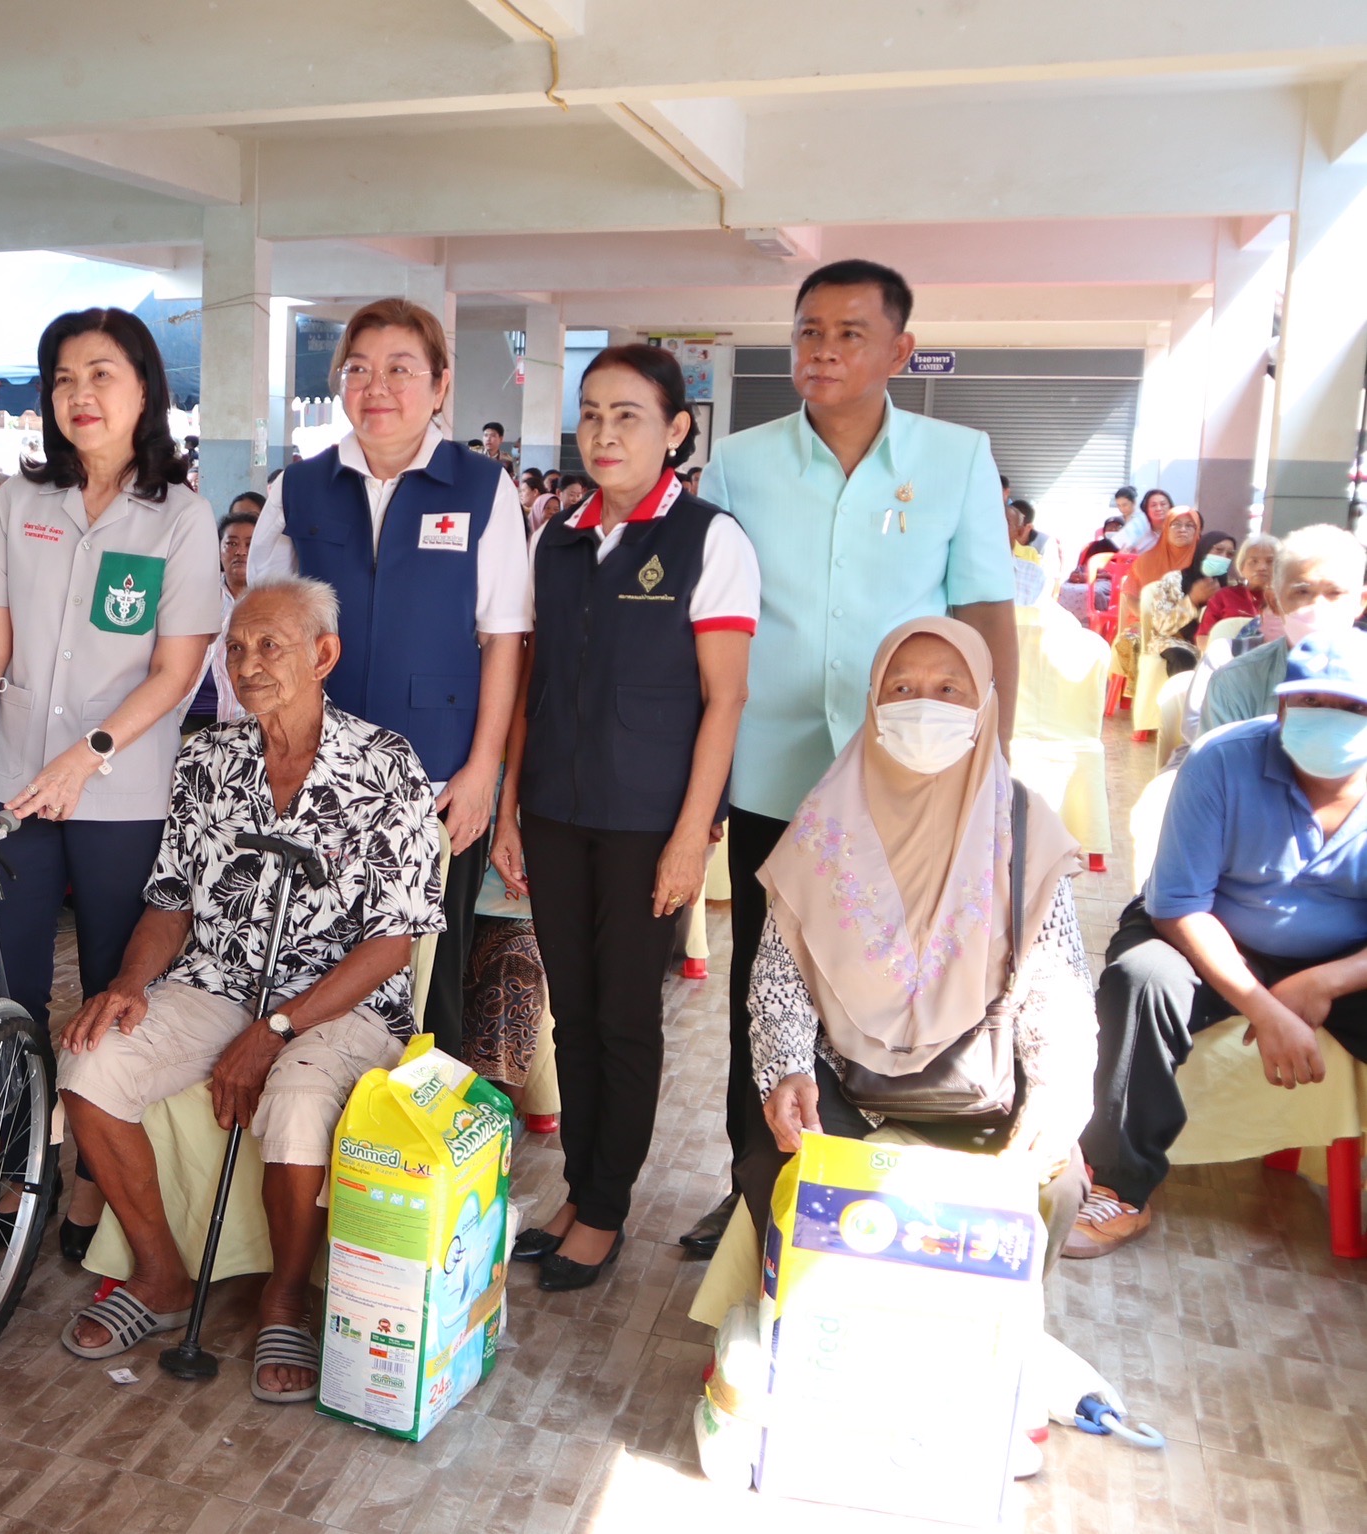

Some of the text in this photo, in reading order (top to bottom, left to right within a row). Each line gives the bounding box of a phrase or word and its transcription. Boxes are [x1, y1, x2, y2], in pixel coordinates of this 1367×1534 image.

[914, 353, 951, 363] โรงอาหาร
[918, 363, 944, 371] CANTEEN
[340, 1139, 434, 1176] Sunmed L-XL
